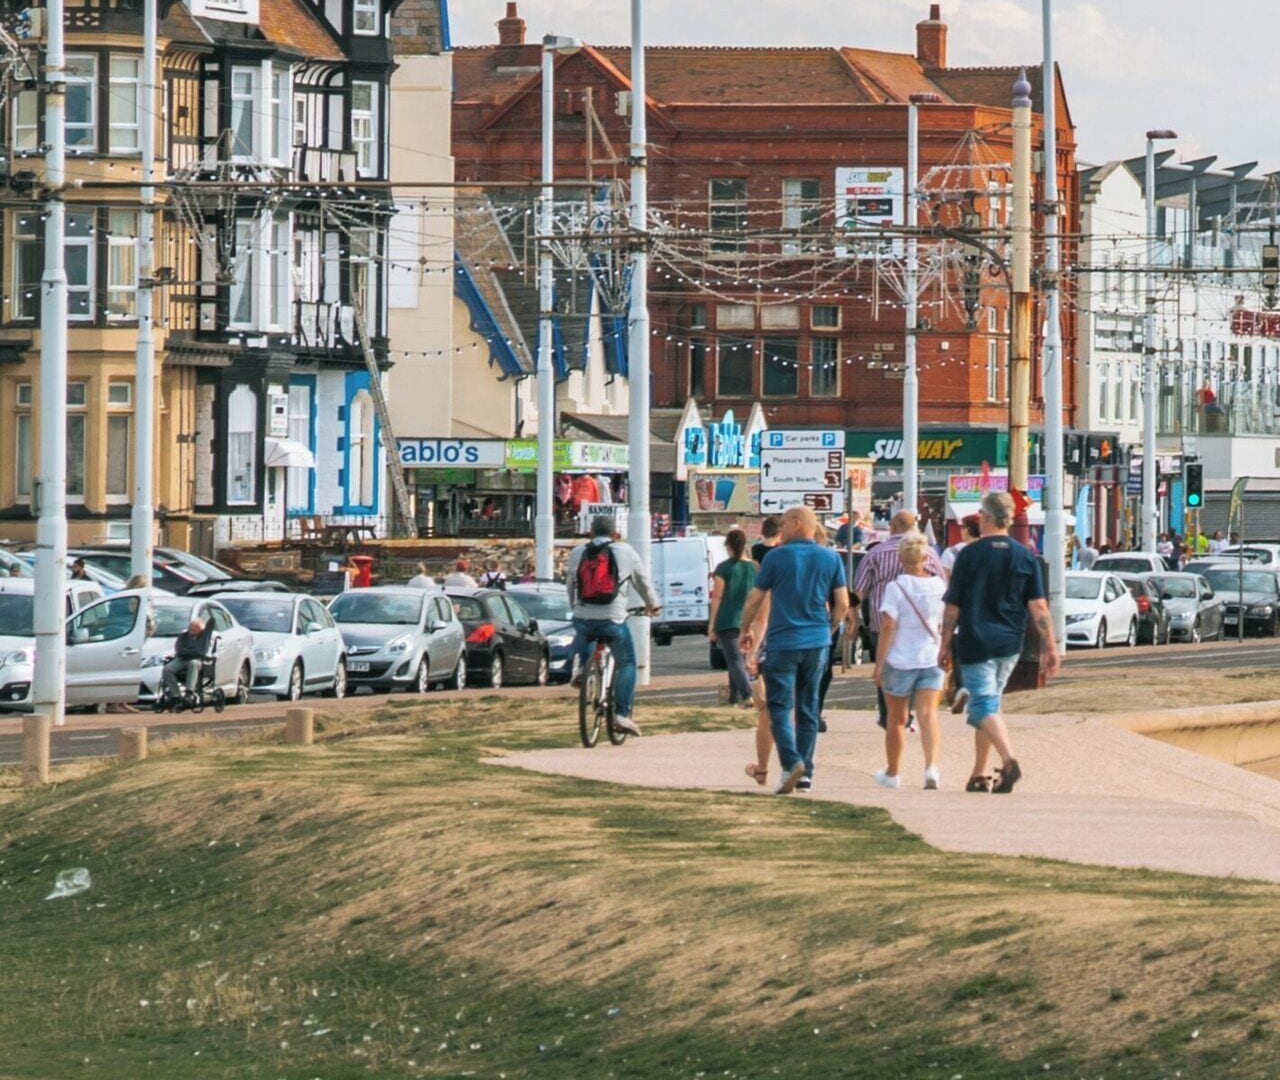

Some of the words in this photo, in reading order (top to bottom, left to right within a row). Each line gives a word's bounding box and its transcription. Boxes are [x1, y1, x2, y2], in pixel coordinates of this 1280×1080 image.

[800, 435, 819, 443] parks
[868, 439, 964, 460] SUWAY
[396, 439, 479, 462] ablo's
